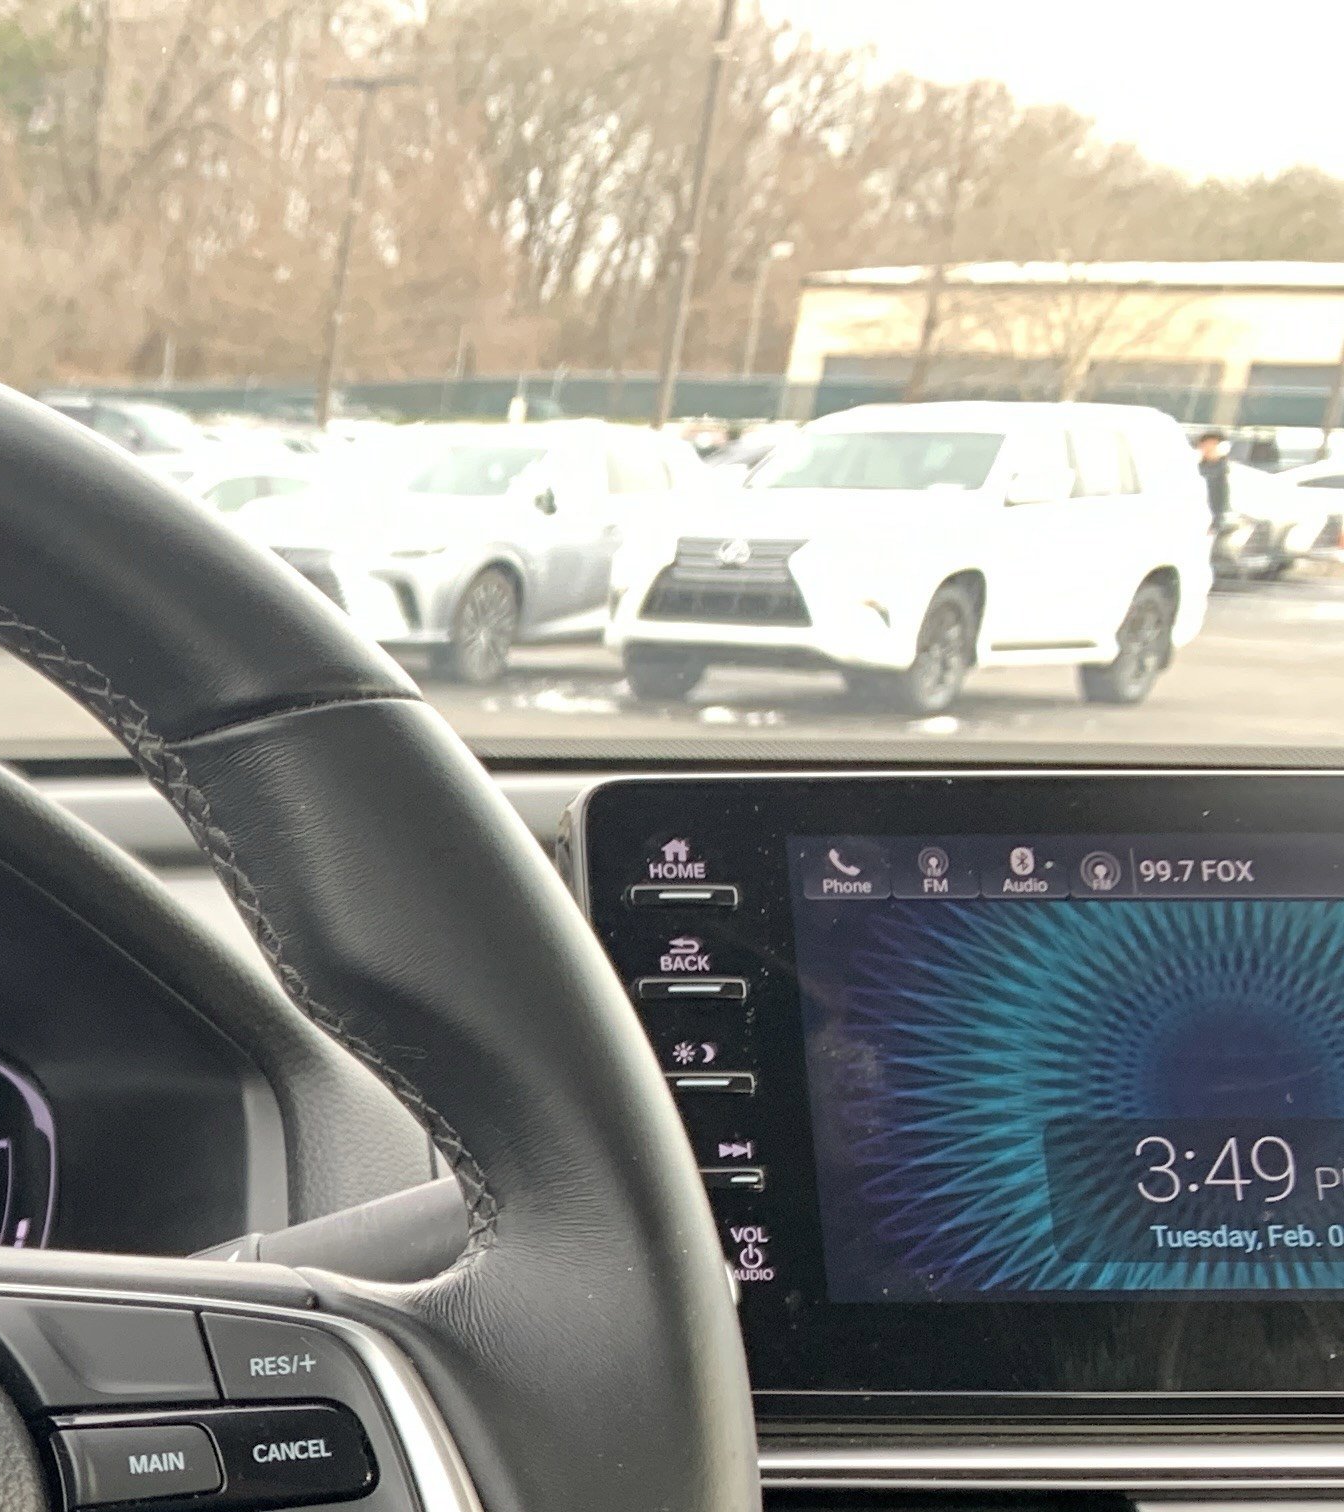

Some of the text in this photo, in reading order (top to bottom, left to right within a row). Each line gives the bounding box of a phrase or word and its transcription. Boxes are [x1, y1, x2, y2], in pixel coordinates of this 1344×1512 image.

[649, 861, 705, 880] HOME
[1139, 860, 1254, 882] 99.7 FOX
[822, 878, 872, 894] Phone
[923, 879, 949, 893] FM
[1002, 878, 1049, 893] Audio
[660, 955, 710, 973] BACK
[1135, 1135, 1344, 1203] 3:49 P
[730, 1226, 769, 1243] VOL
[1150, 1225, 1263, 1254] Tuesday,
[1268, 1224, 1323, 1247] Feb.
[732, 1268, 775, 1281] AUDIO
[252, 1438, 332, 1464] CANCEL
[128, 1451, 185, 1475] MAIN
